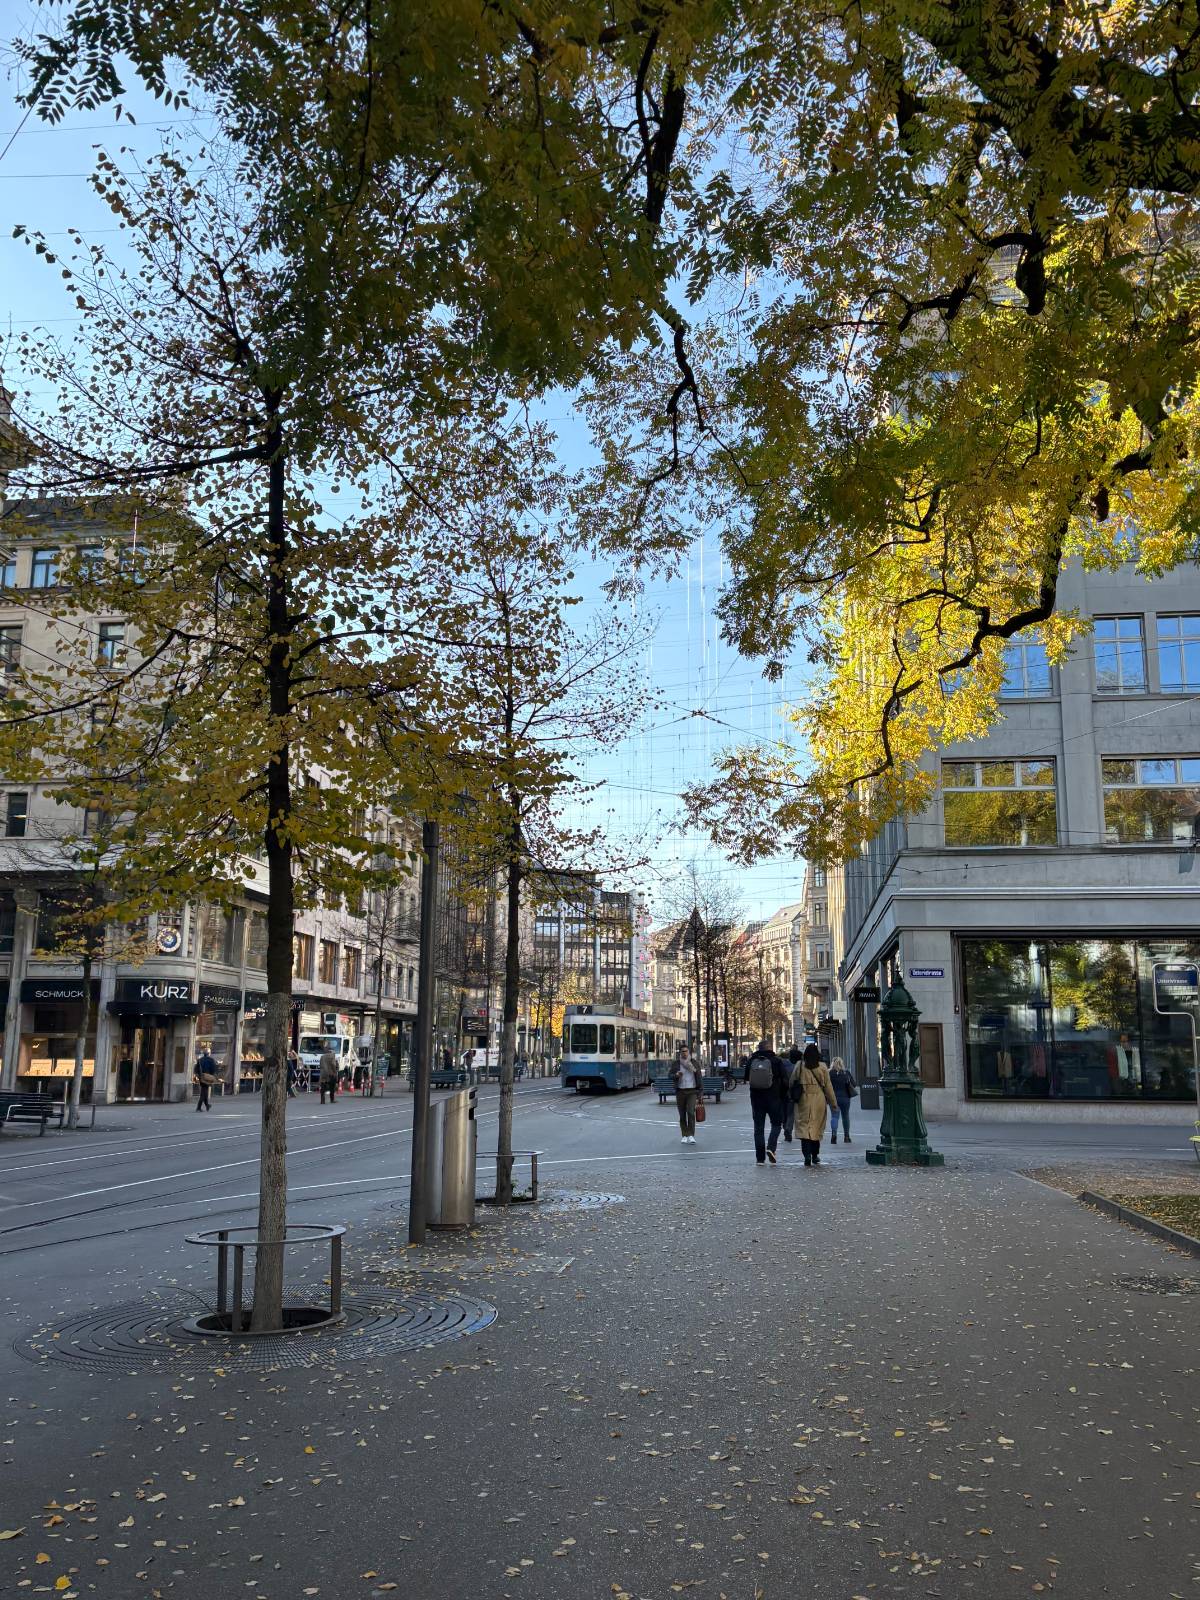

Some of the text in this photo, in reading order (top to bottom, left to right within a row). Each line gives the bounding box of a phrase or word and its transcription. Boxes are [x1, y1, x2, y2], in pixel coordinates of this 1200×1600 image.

[34, 990, 84, 998] SCHMUCK
[140, 985, 189, 999] KURZ
[582, 1006, 588, 1014] 7
